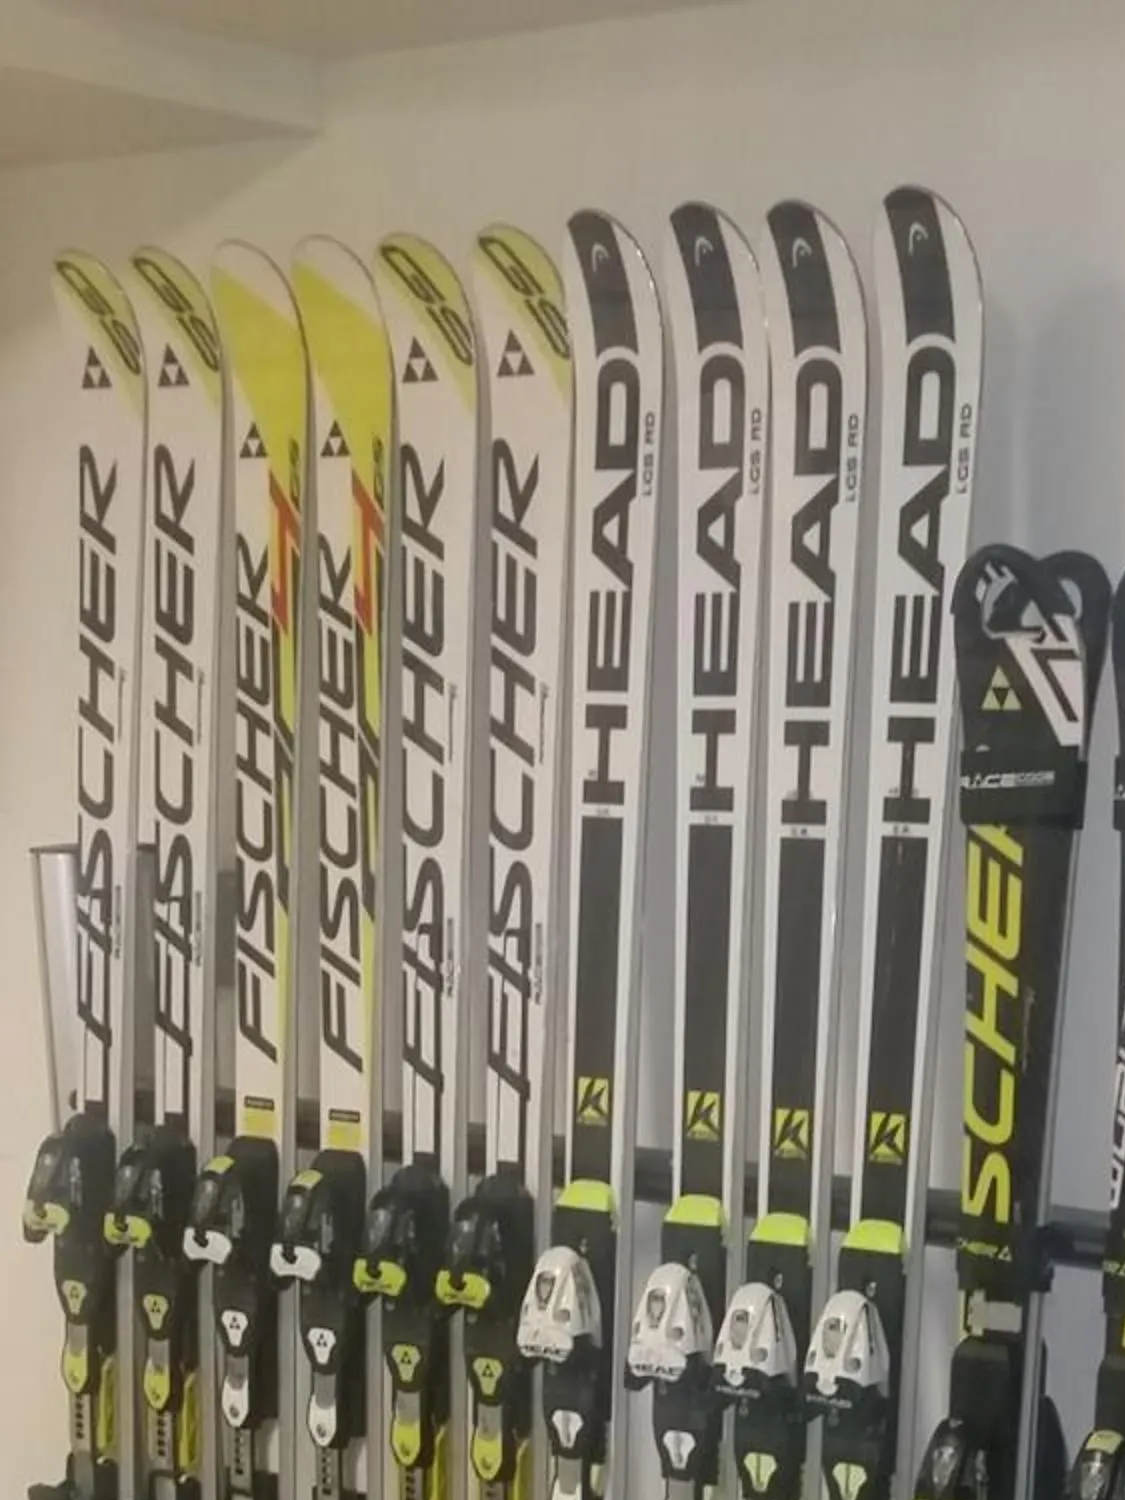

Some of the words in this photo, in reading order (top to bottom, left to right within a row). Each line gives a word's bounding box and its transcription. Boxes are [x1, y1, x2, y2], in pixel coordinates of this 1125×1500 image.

[77, 444, 117, 1048] FISCHER
[153, 443, 196, 1056] FISCHER
[235, 532, 278, 1064] FISCHER
[318, 532, 363, 1074] FISCHER
[399, 442, 446, 1094] FISCHER
[487, 438, 540, 1101] FISCHER
[583, 356, 641, 805] HEAD
[689, 354, 745, 812] HEAD
[781, 358, 843, 824] HEAD
[882, 346, 956, 823] HEAD
[961, 824, 1024, 1224] SCHE
